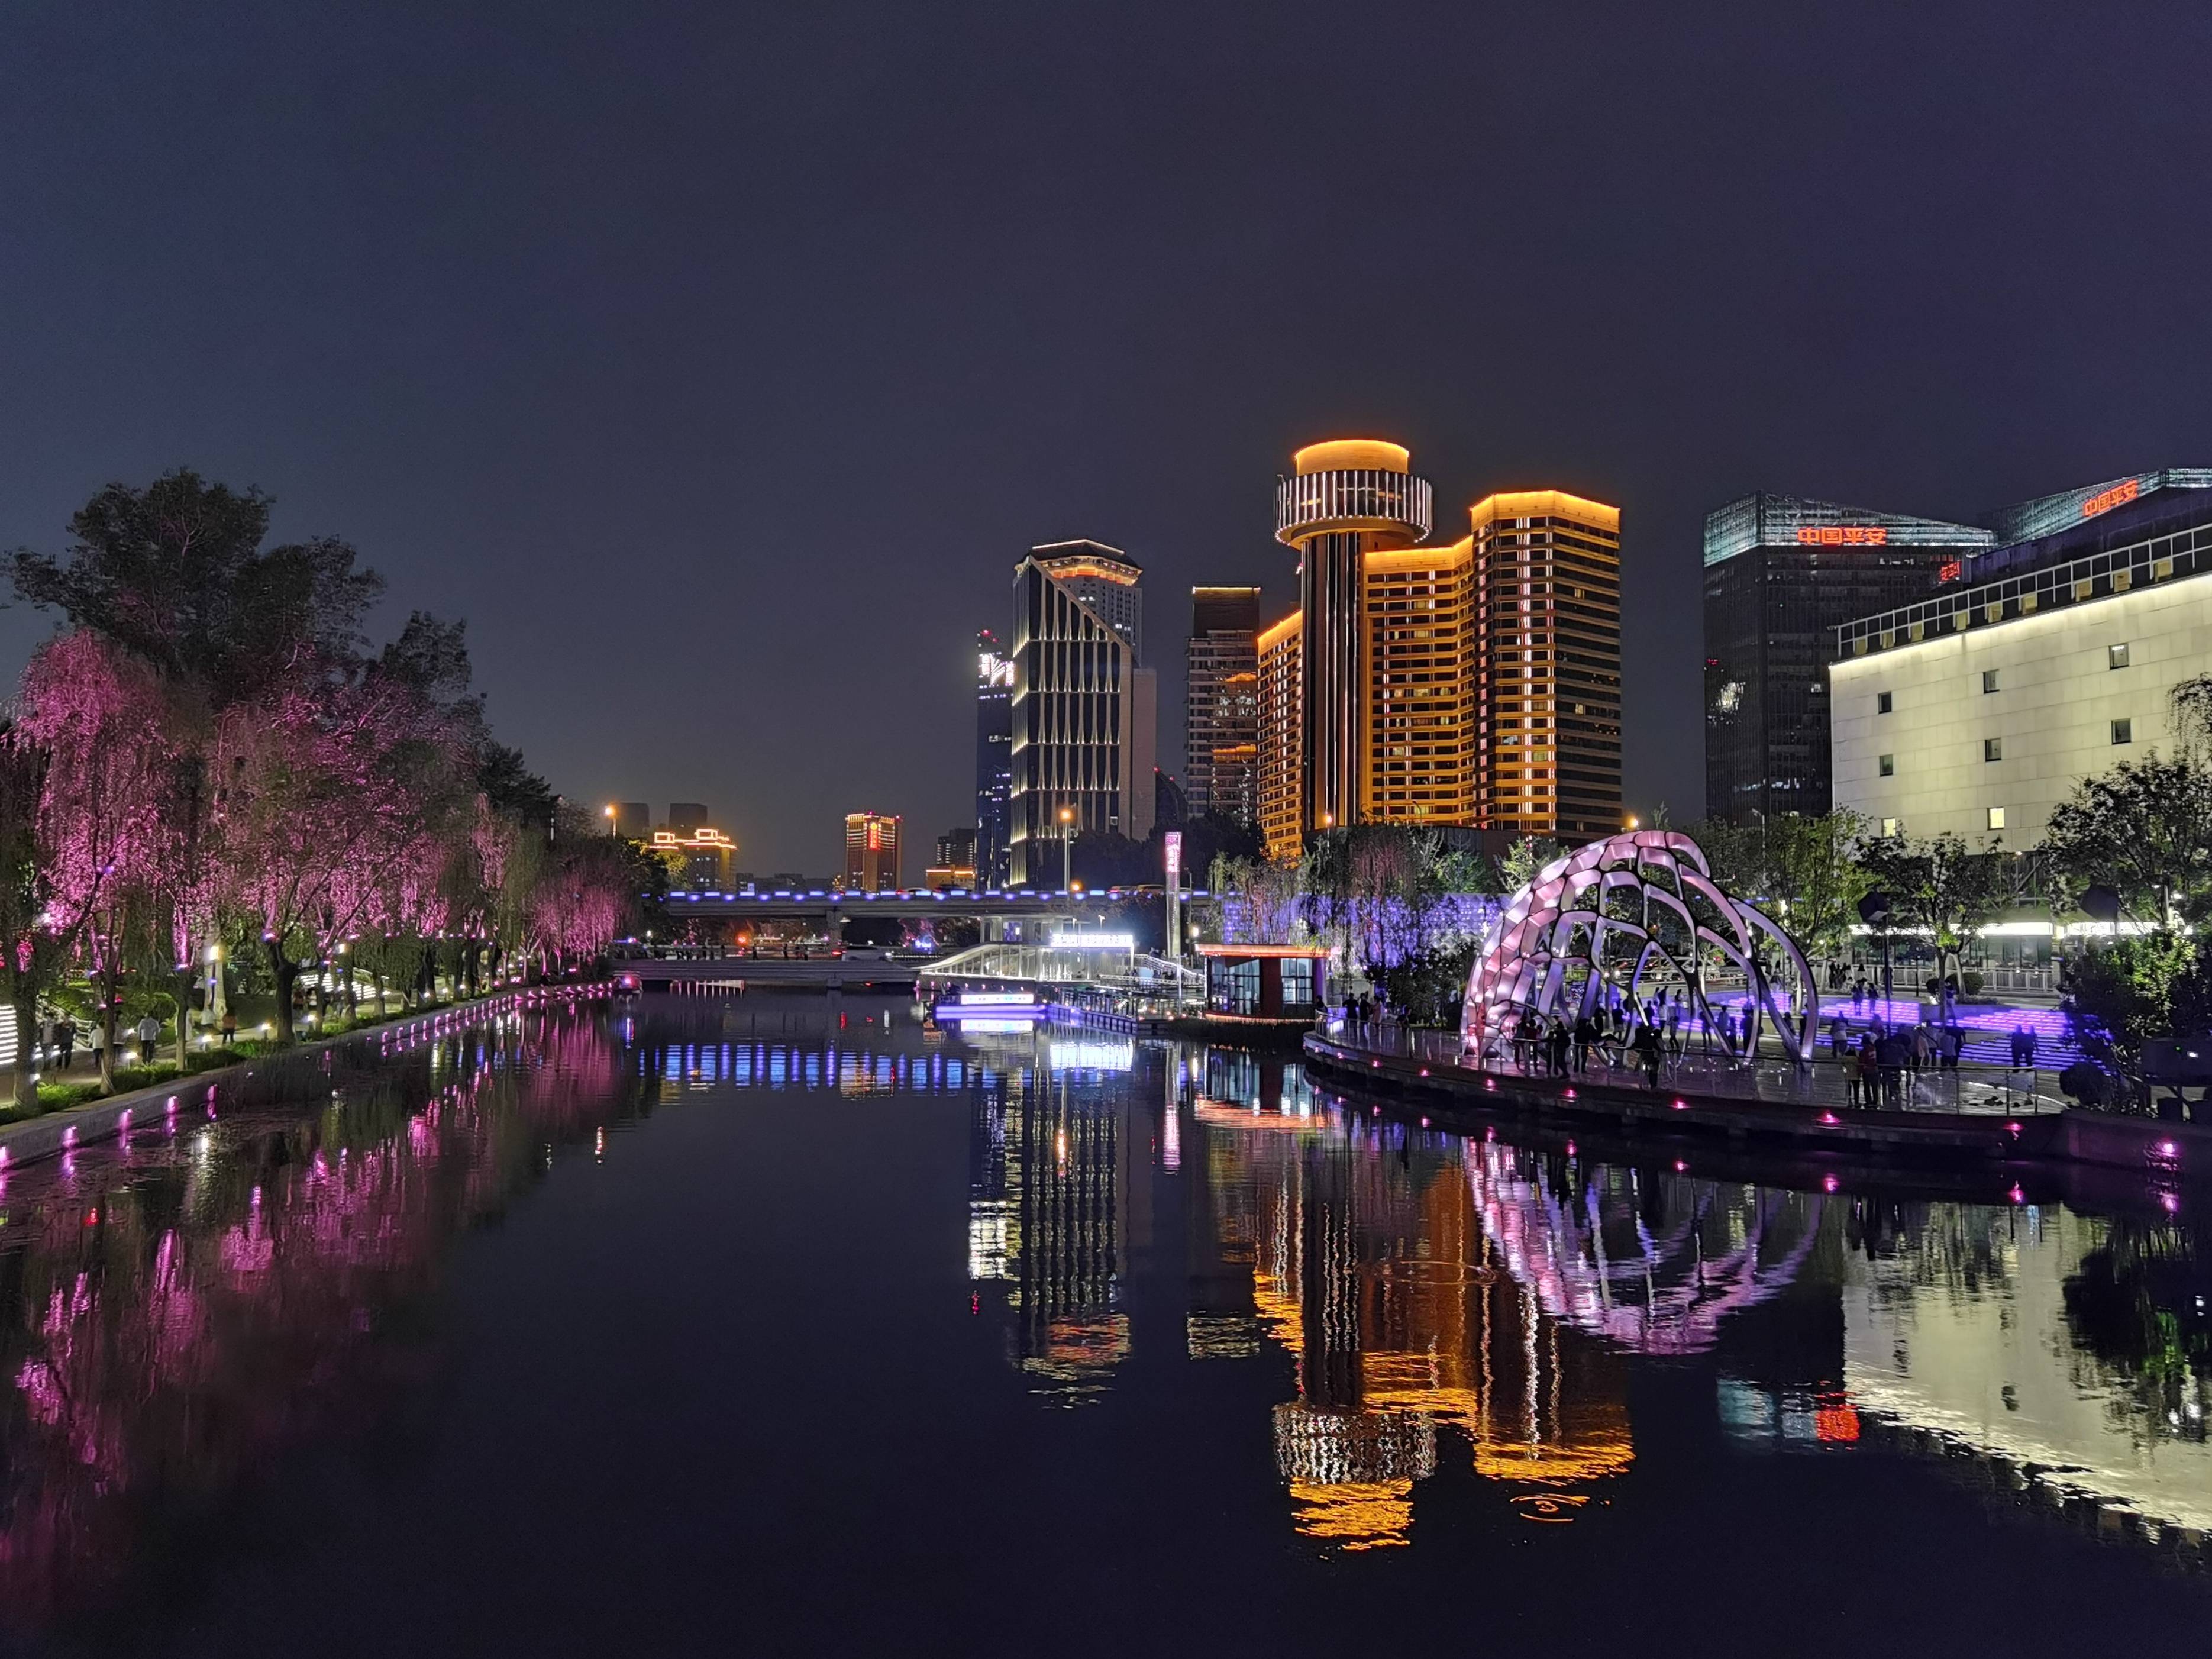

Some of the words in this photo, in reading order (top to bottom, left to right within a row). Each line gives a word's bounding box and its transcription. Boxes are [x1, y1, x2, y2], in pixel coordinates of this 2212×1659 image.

[2084, 479, 2138, 517] 中国平安
[1797, 527, 1887, 544] 中国平安
